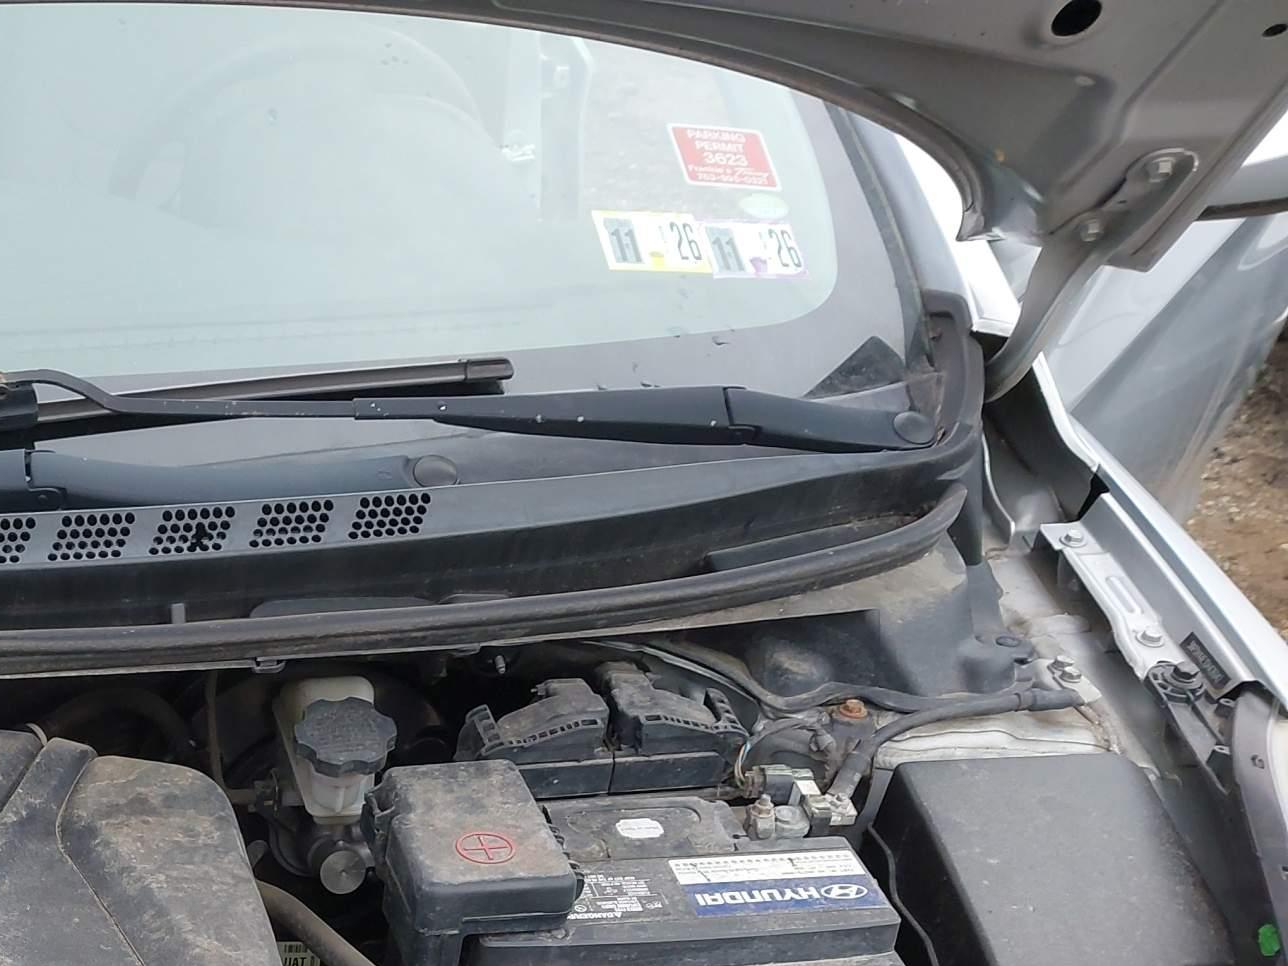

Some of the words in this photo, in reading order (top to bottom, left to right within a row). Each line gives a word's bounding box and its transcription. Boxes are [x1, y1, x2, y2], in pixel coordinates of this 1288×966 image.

[687, 129, 746, 143] PARKING
[695, 140, 744, 153] PERMIT
[611, 228, 642, 262] 11
[669, 221, 702, 260] 26
[713, 237, 744, 271] 11
[768, 228, 802, 267] 26
[695, 886, 821, 906] HYUNDAI
